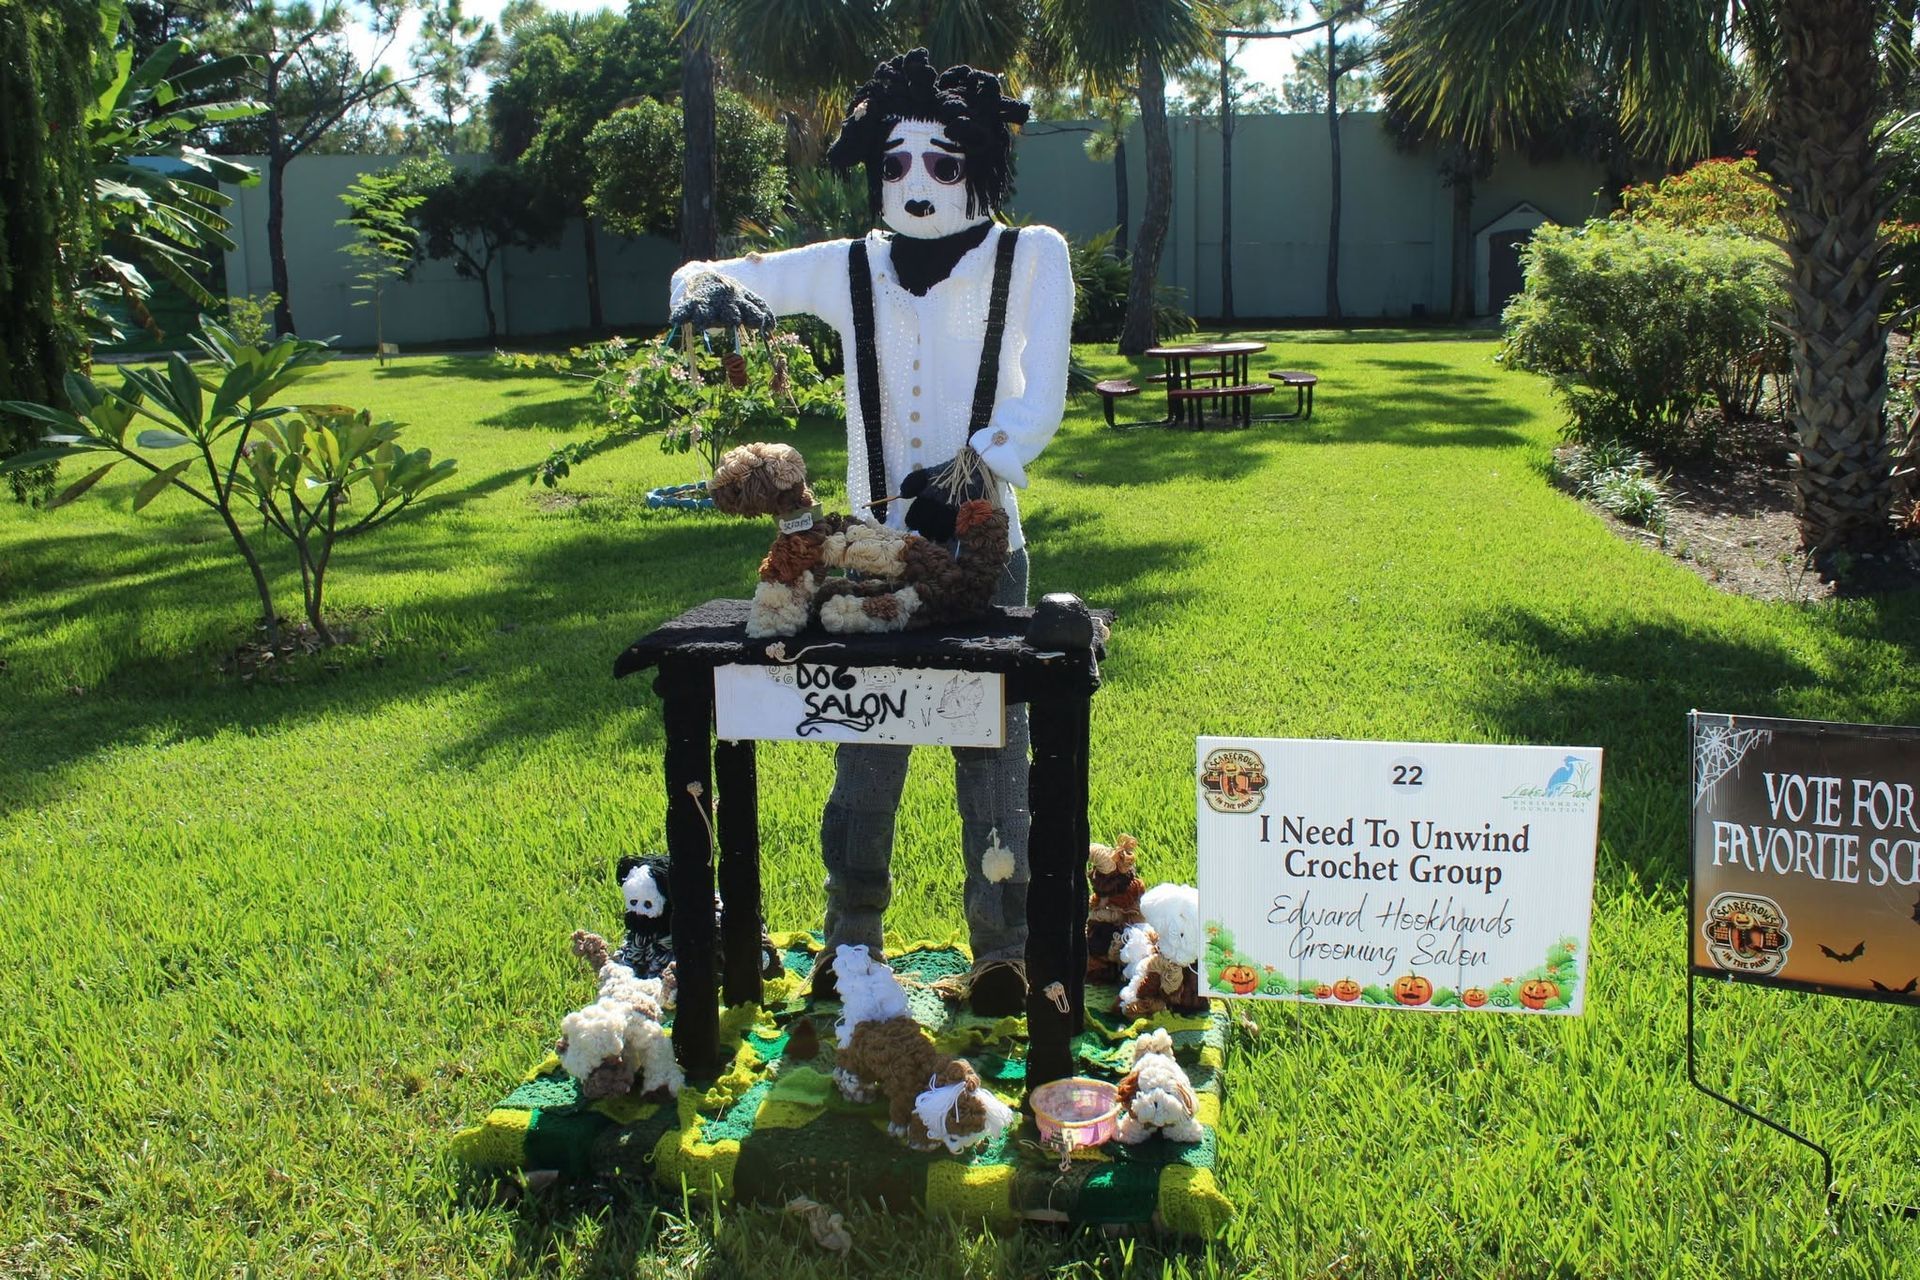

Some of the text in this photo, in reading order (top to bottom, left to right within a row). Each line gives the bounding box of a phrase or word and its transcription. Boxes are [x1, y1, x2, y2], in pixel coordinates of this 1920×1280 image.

[796, 663, 857, 690] DOG
[805, 690, 907, 724] SALON
[1209, 752, 1259, 769] SCARECROWS
[1393, 765, 1423, 786] 22
[1237, 797, 1253, 809] PARK
[1763, 772, 1920, 833] VOTE FOR
[1260, 815, 1530, 853] I Need To Unwind
[1712, 821, 1860, 884] FAVORITE
[1285, 850, 1501, 894] Crochet Group
[1267, 890, 1515, 938] Edward Hookhands
[1717, 901, 1777, 923] SCARECROWS
[1289, 926, 1490, 976] Grooming Salon
[1722, 951, 1771, 969] IN THE PARK
